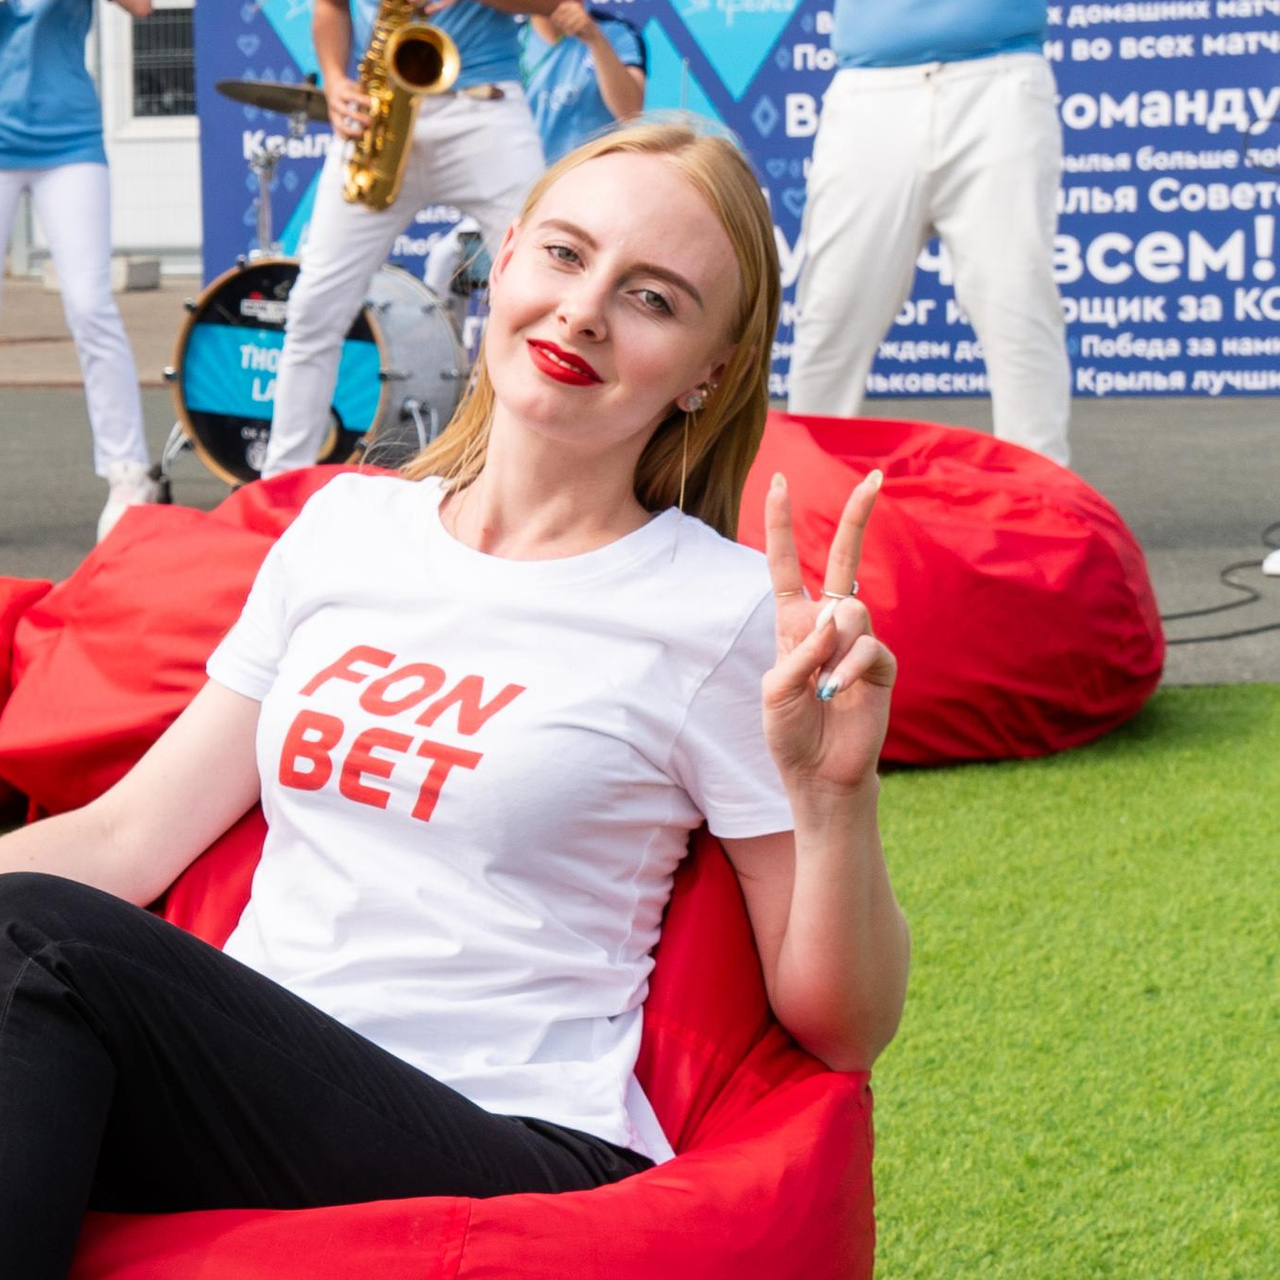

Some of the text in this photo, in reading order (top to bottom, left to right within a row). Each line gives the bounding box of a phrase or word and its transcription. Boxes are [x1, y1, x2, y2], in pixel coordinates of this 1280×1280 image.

[1067, 0, 1211, 29] домашних
[1071, 37, 1113, 61] во
[1119, 33, 1195, 60] всех
[1054, 87, 1280, 136] оманду
[1136, 145, 1240, 171] больше
[1148, 176, 1280, 213] Совет
[1053, 214, 1276, 285] всем!
[1177, 294, 1223, 322] за
[1081, 332, 1181, 361] Победа
[1186, 337, 1216, 357] за
[866, 373, 991, 394] ьковски
[1076, 366, 1187, 397] Крылья
[298, 644, 527, 737] FON
[278, 709, 484, 823] BET
